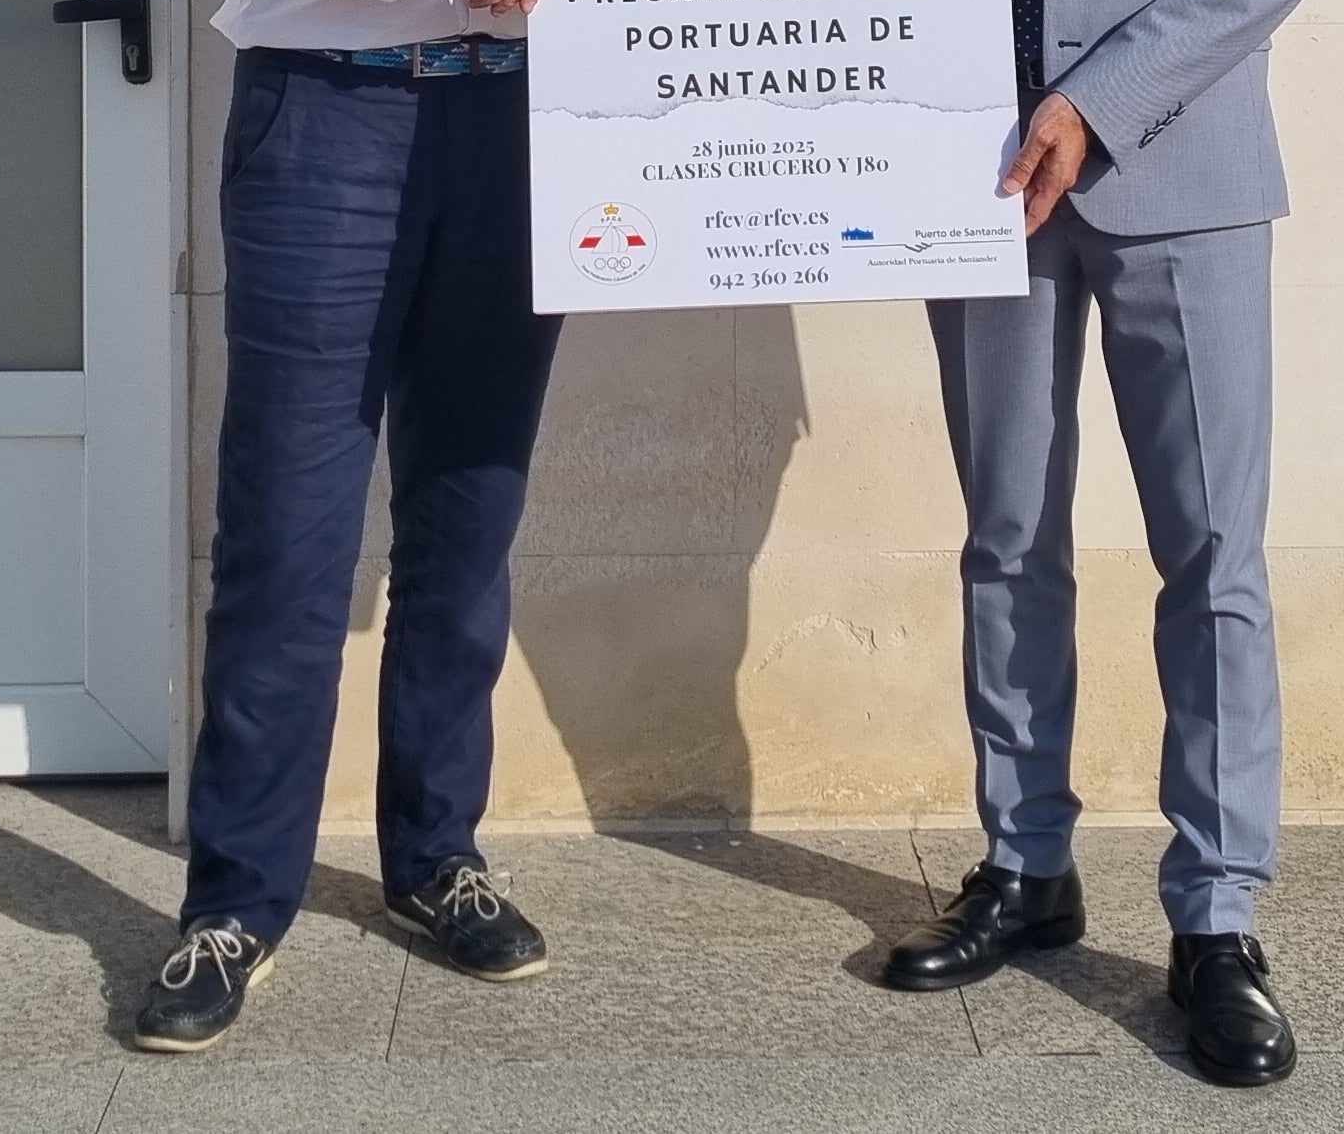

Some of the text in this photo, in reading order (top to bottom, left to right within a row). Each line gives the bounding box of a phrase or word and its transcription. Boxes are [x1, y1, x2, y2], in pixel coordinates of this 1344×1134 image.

[625, 15, 915, 52] PORTUARIA DE
[656, 65, 888, 100] SANTANDER
[691, 138, 816, 160] 28 junio 2025
[642, 155, 890, 182] CLASES CRUCERO Y J80
[704, 207, 830, 231] rfcv@rfcv.es
[915, 226, 1014, 239] Puerto de Santander
[706, 238, 831, 260] www.rfcv.es
[709, 265, 830, 291] 942 360 266
